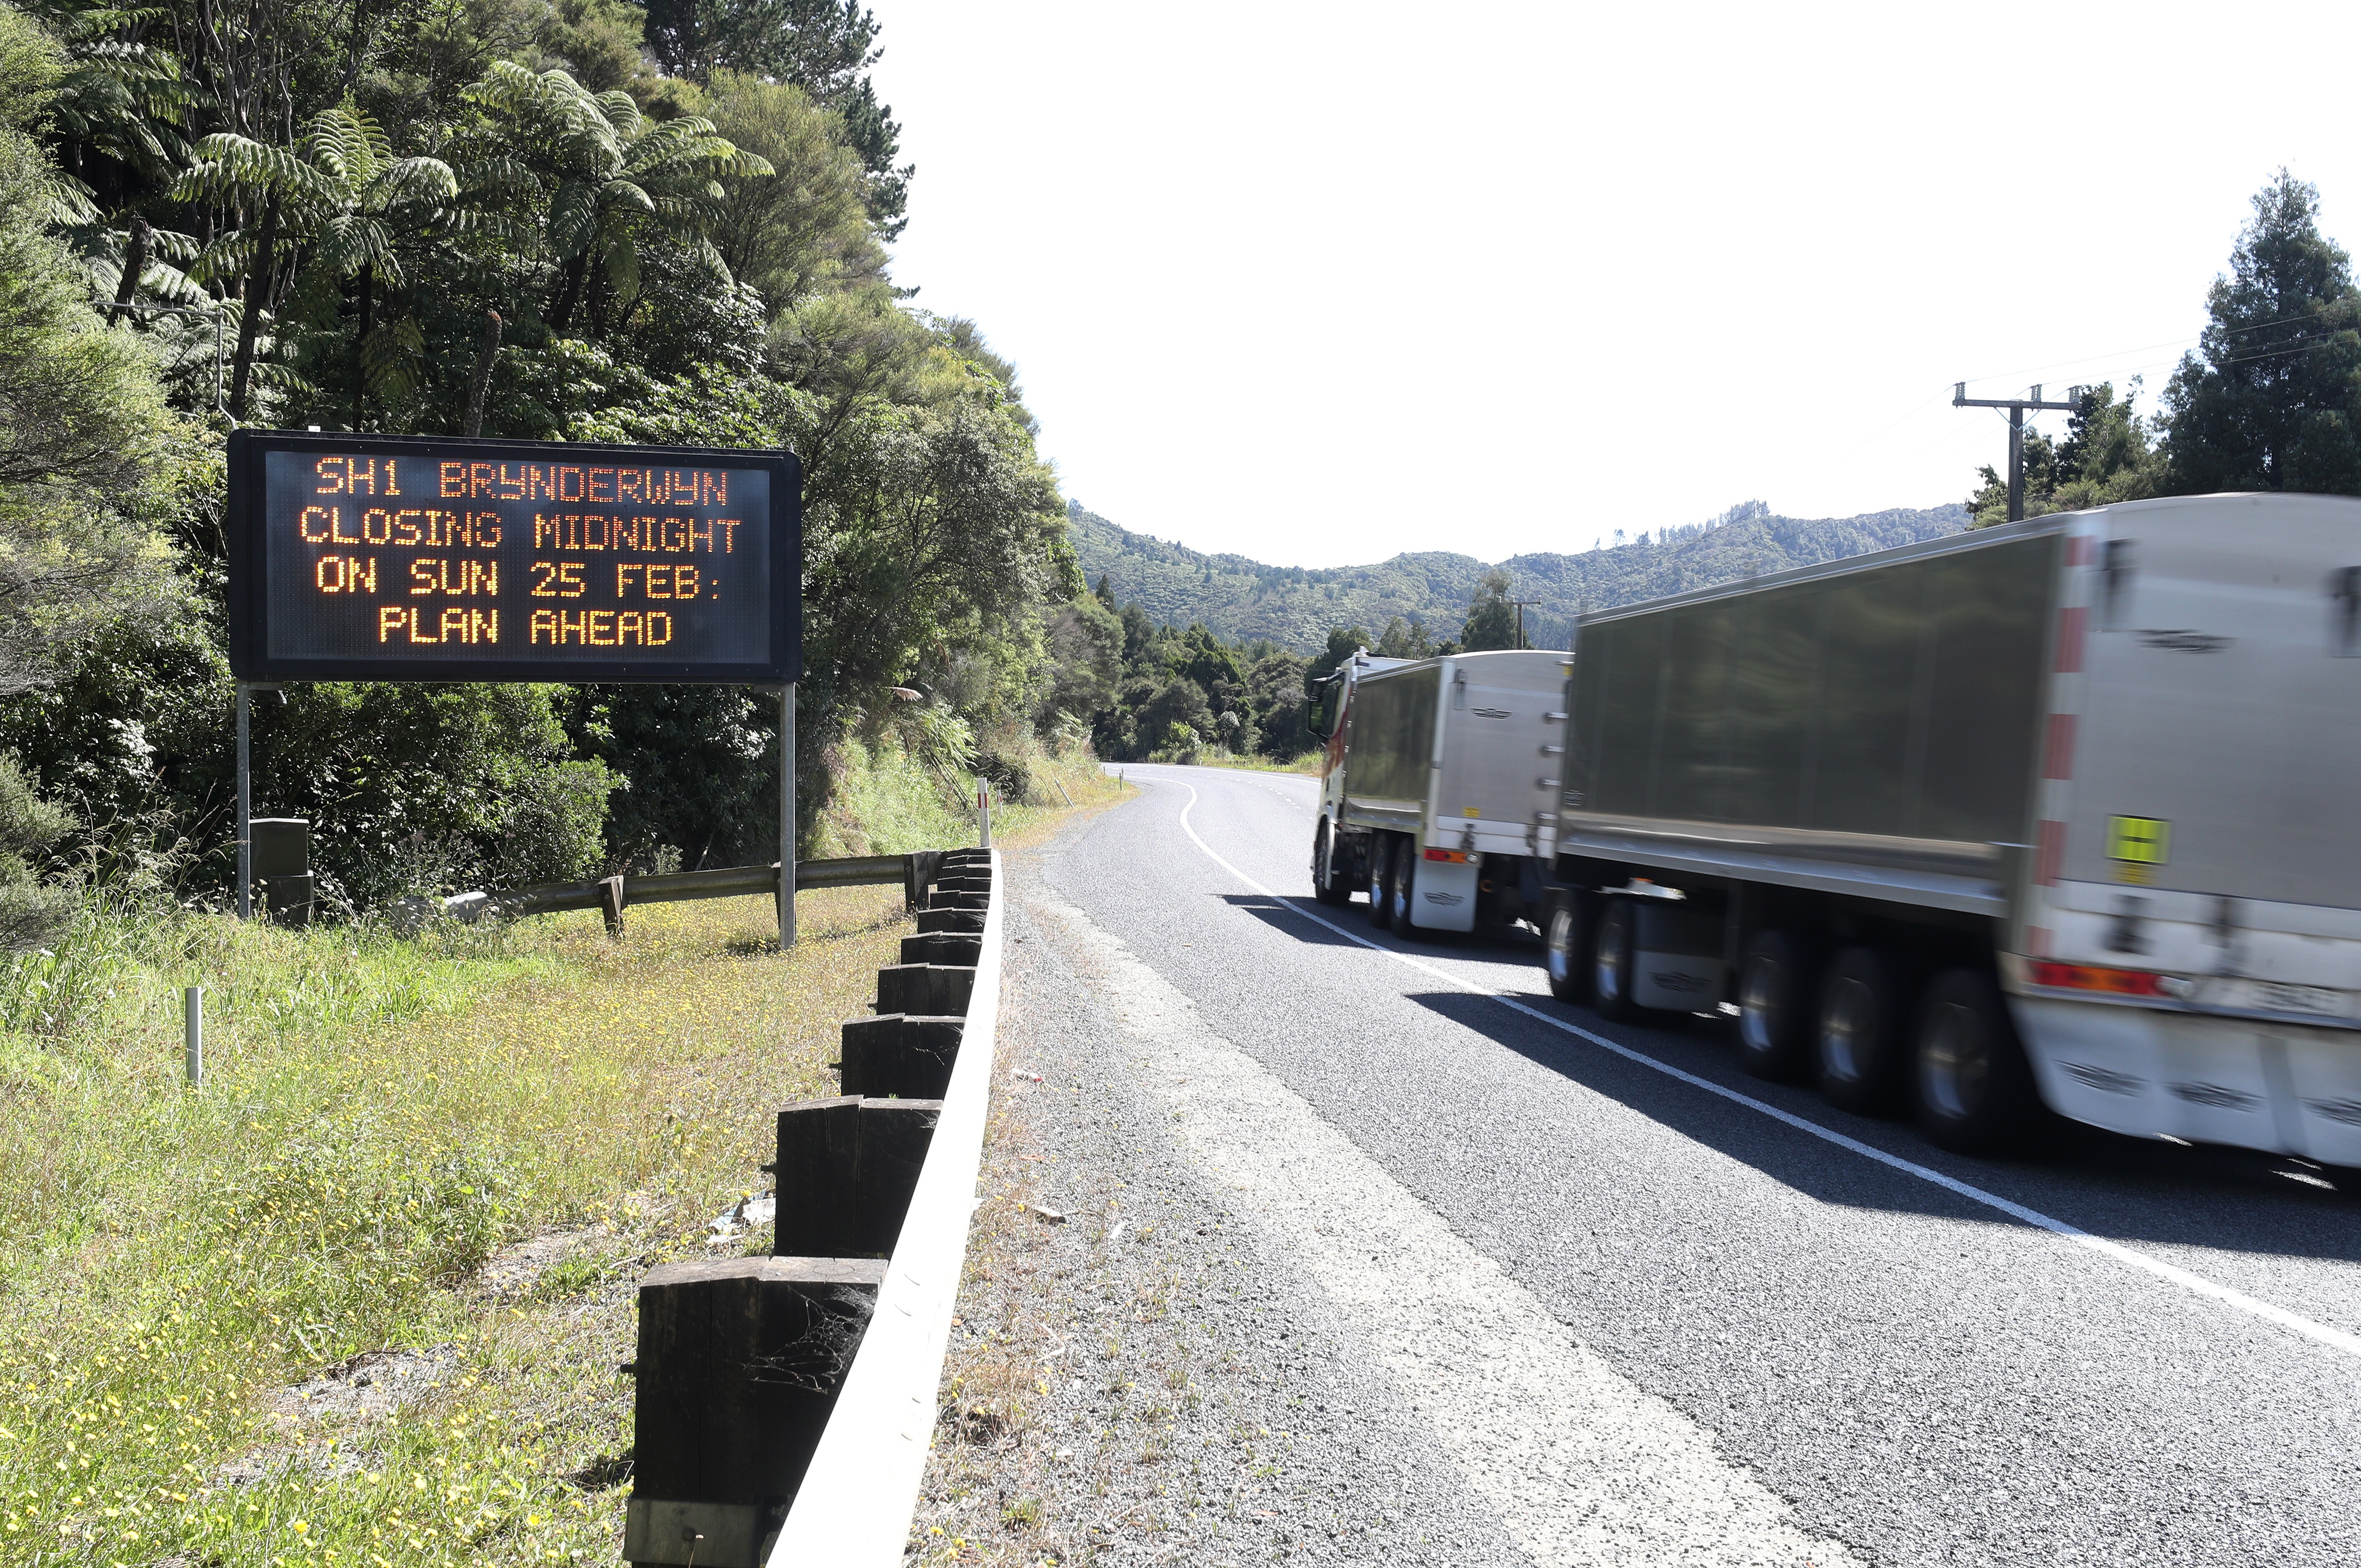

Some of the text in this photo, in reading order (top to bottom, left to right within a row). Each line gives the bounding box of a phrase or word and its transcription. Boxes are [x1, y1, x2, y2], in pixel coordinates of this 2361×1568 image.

[316, 457, 726, 505] SH1 BRYNDERWYN
[299, 506, 740, 552] CLOSING MIDNIGHT
[316, 554, 376, 593] ON
[410, 558, 498, 596] SUN
[530, 562, 586, 597] 25
[379, 606, 672, 645] PLAN AHEAD
